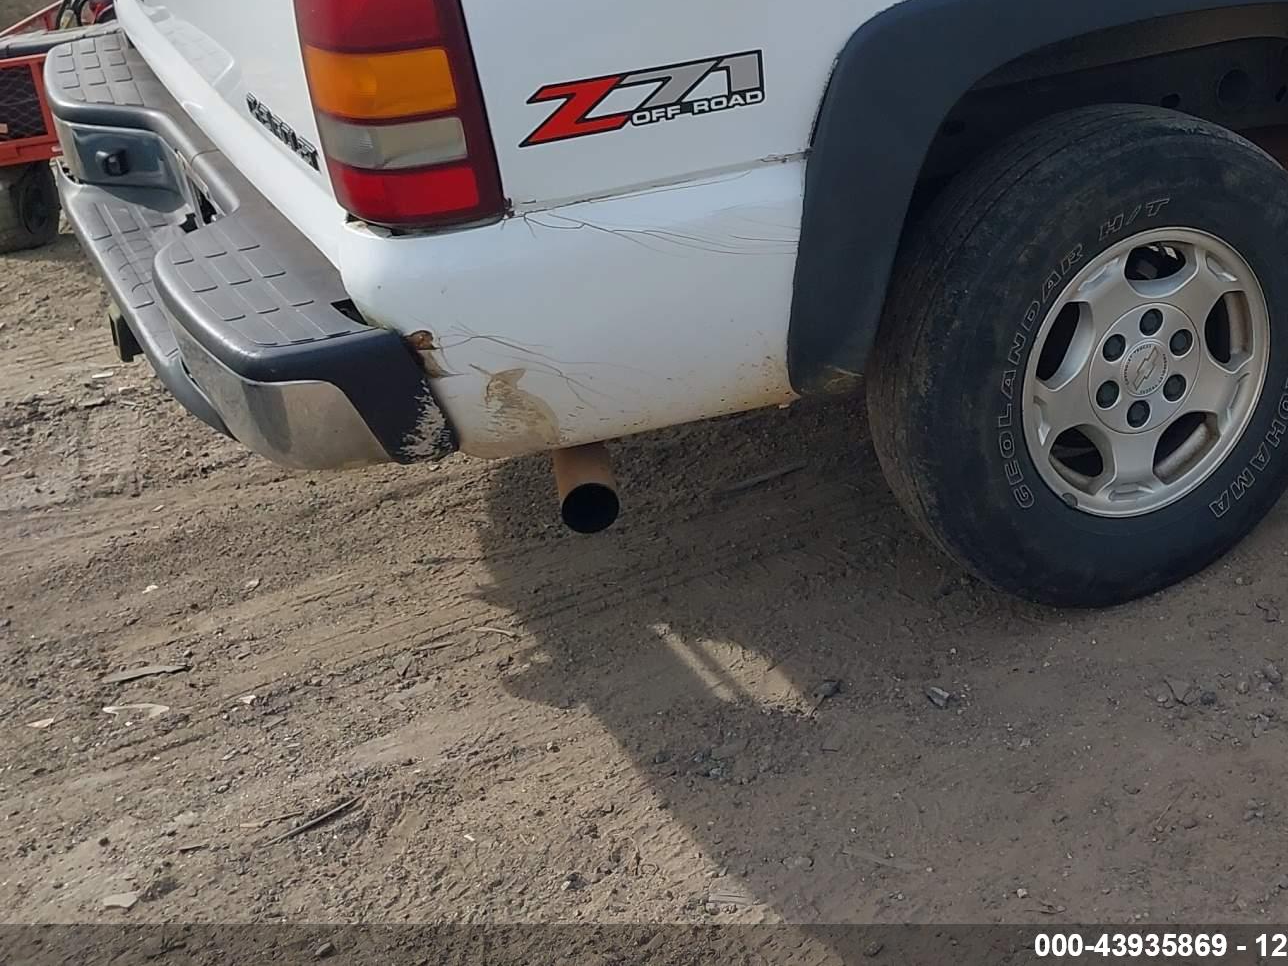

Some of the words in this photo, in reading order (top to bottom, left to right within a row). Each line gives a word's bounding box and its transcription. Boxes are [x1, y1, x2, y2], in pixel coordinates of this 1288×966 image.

[518, 49, 763, 148] Z71
[632, 105, 681, 126] OFF
[693, 90, 763, 115] ROAD
[998, 243, 1084, 509] GEOLANDAR
[1099, 198, 1171, 242] H/T
